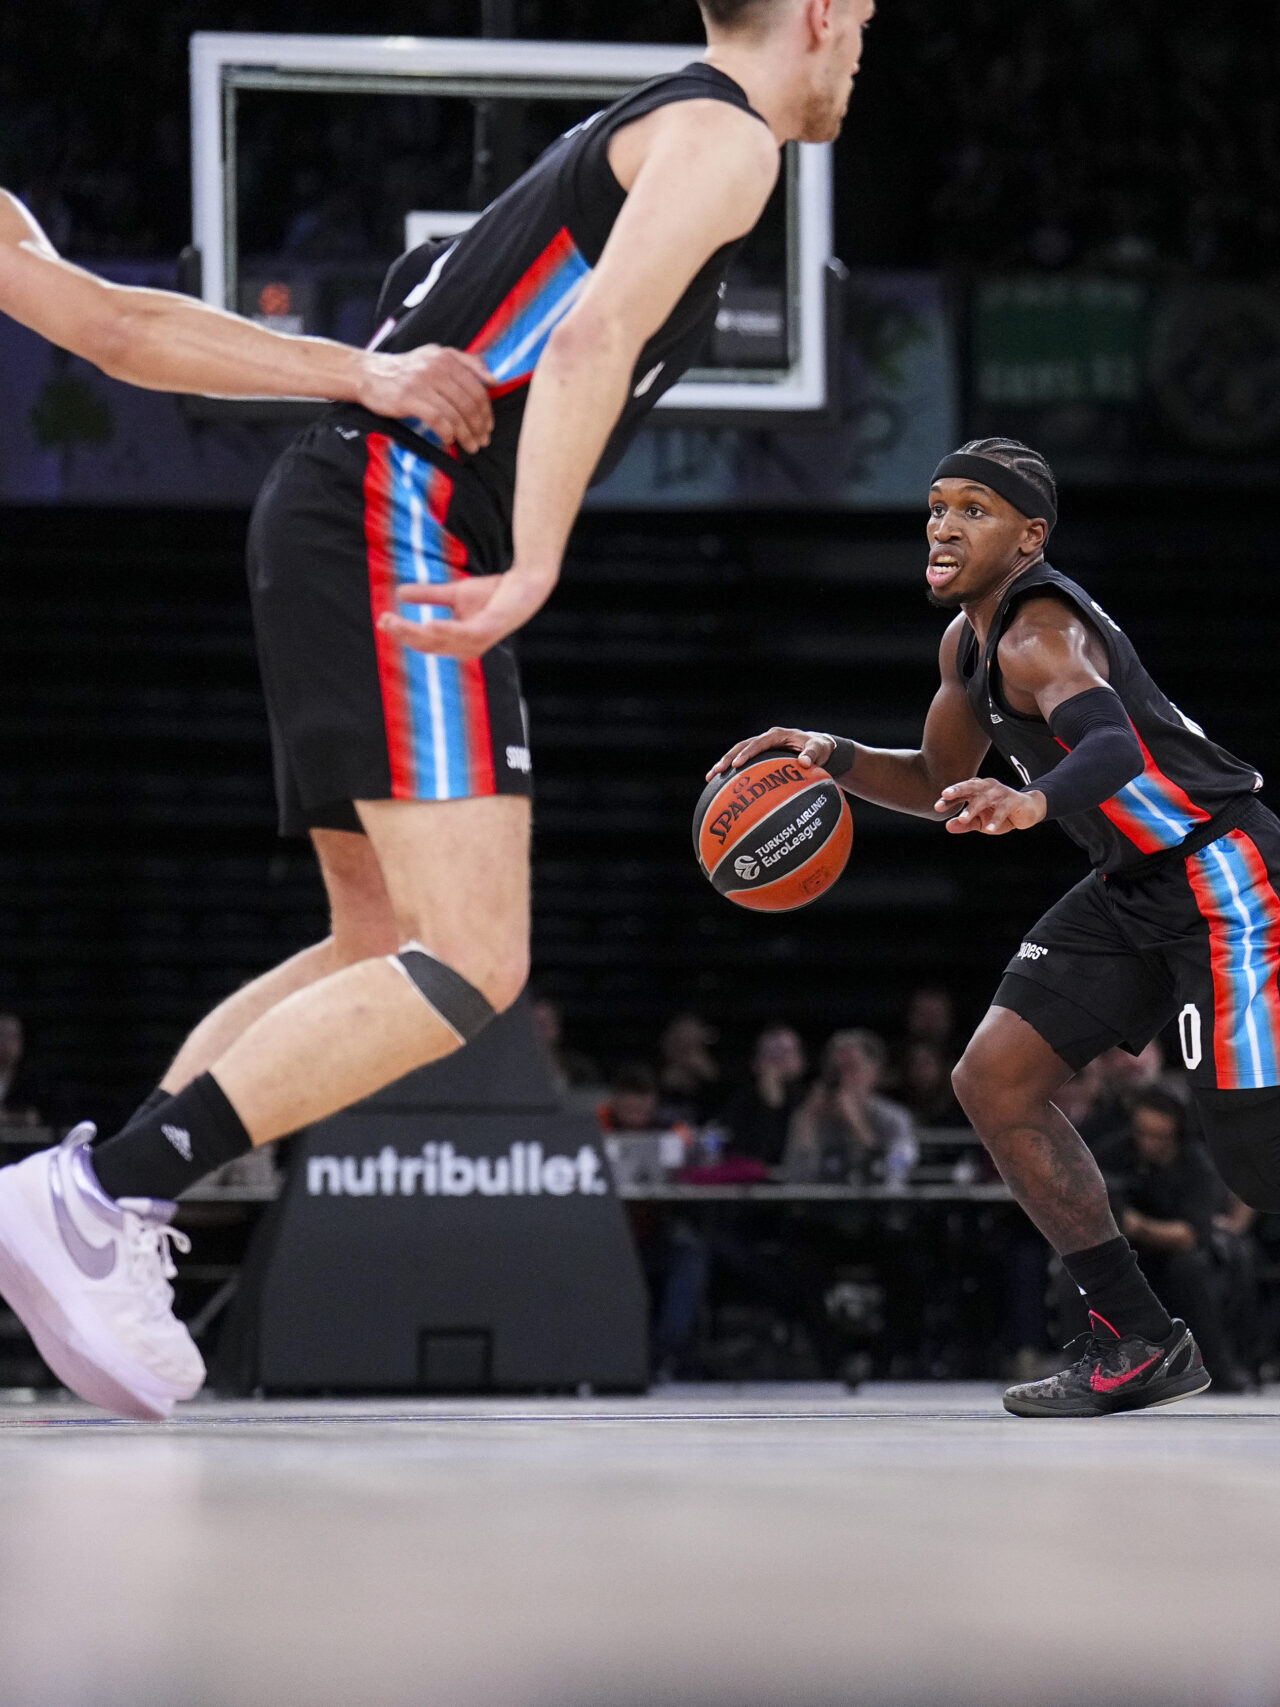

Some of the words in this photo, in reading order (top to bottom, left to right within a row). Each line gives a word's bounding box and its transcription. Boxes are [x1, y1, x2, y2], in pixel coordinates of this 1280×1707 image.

[709, 763, 804, 845] SPALDING
[755, 824, 797, 857] TURKISH
[796, 794, 827, 828] AIRLINES
[761, 817, 822, 868] EuroLeague
[1178, 1003, 1202, 1070] 0
